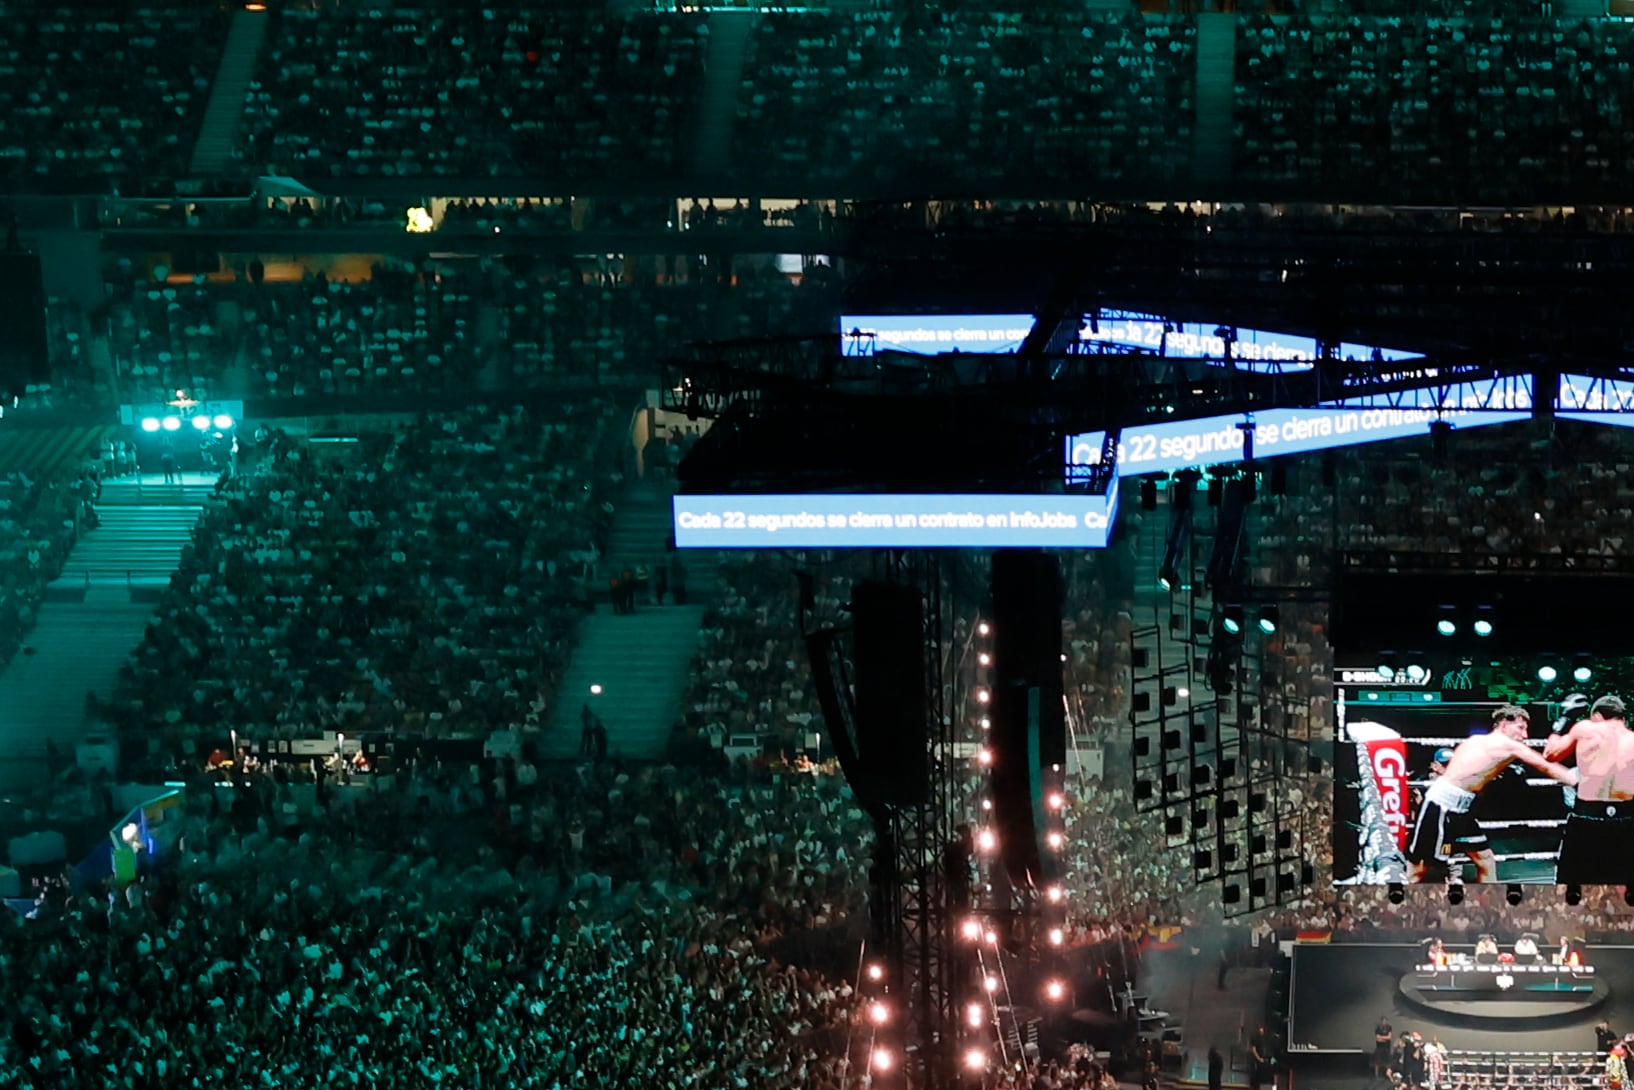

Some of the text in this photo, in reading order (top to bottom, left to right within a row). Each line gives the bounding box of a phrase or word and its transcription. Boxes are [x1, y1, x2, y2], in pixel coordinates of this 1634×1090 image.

[1072, 443, 1126, 464] Caa
[1129, 434, 1157, 462] 22
[1160, 424, 1244, 461] segundo
[1256, 424, 1279, 445] se
[1282, 415, 1332, 441] cierra
[1335, 411, 1358, 434] un
[678, 511, 722, 528] Cada
[722, 511, 746, 528] 22
[747, 511, 826, 532] segundos
[827, 514, 847, 528] se
[848, 511, 893, 528] cierra
[895, 514, 917, 528] un
[918, 511, 984, 528] contrato
[986, 514, 1008, 528] en
